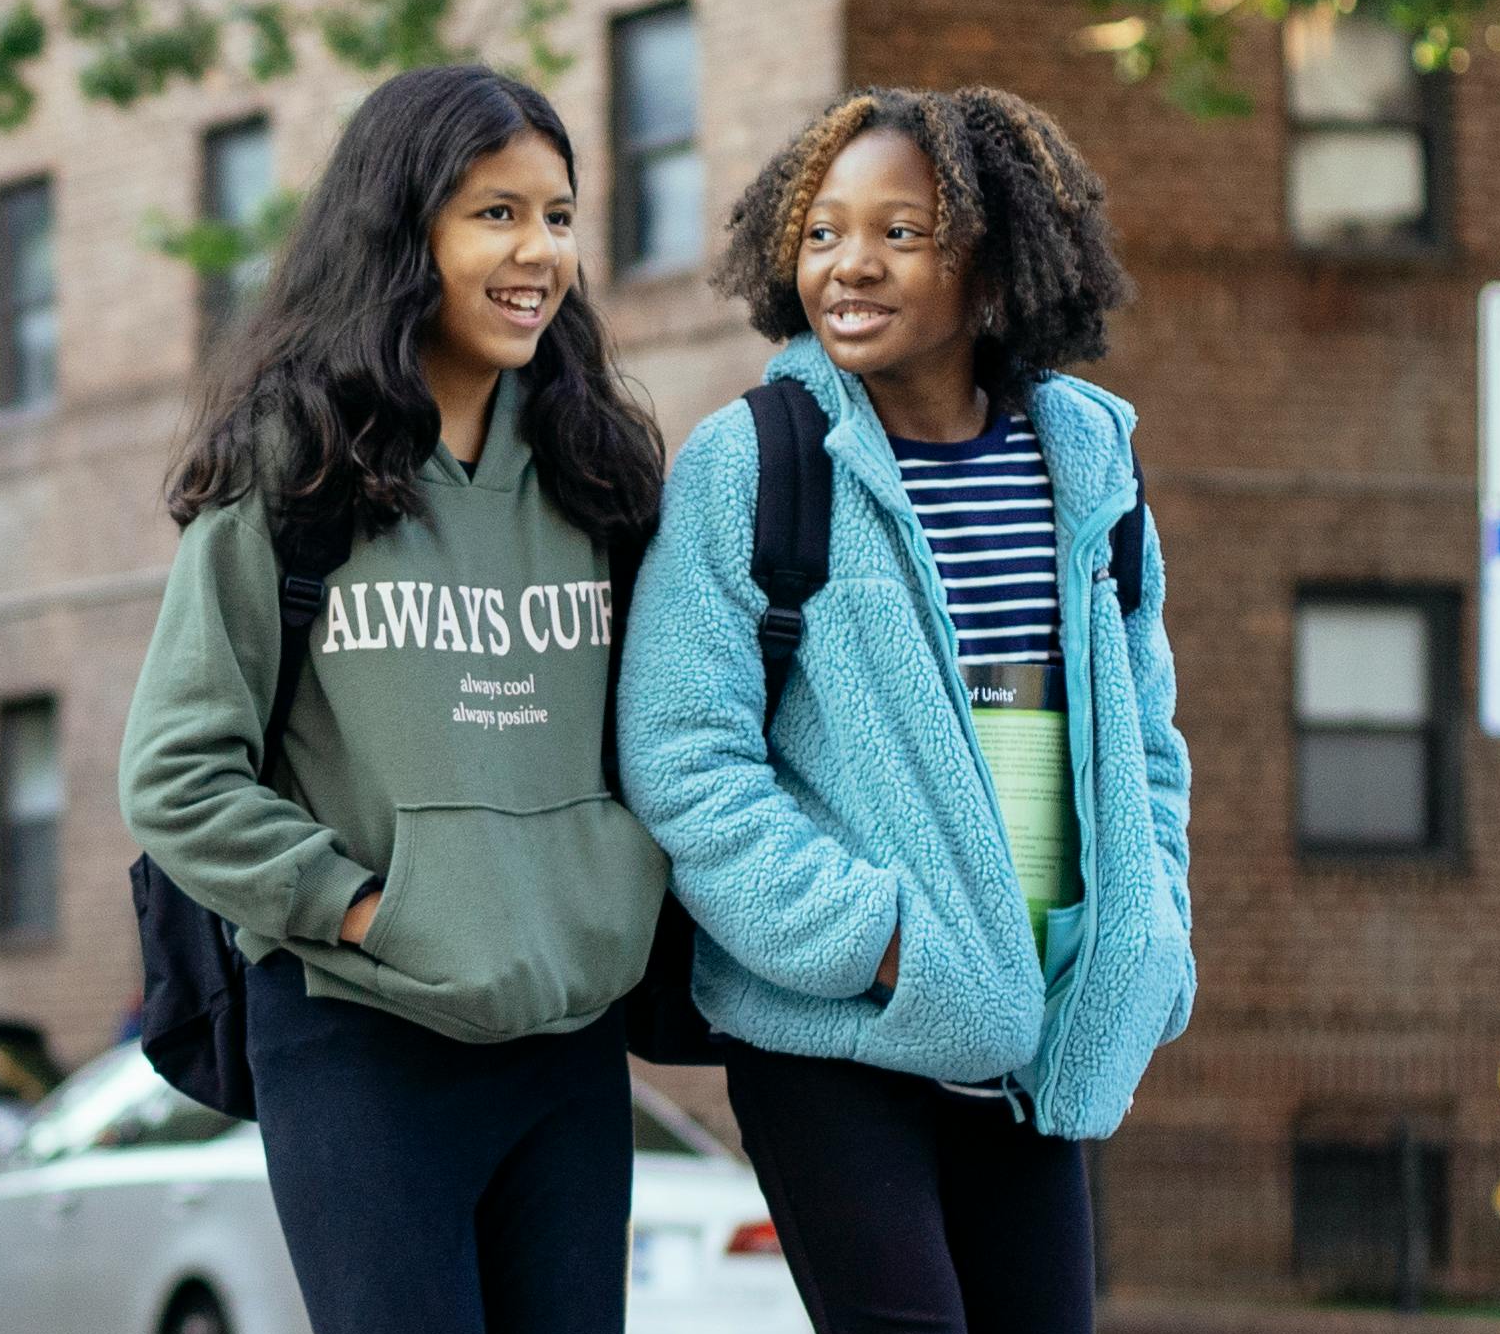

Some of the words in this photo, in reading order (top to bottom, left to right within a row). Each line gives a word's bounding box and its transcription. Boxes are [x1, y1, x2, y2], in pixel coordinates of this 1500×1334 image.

[322, 581, 511, 656] ALWAYS
[460, 672, 502, 700] always
[503, 673, 535, 696] cool
[452, 701, 496, 730] always
[497, 704, 548, 731] positive
